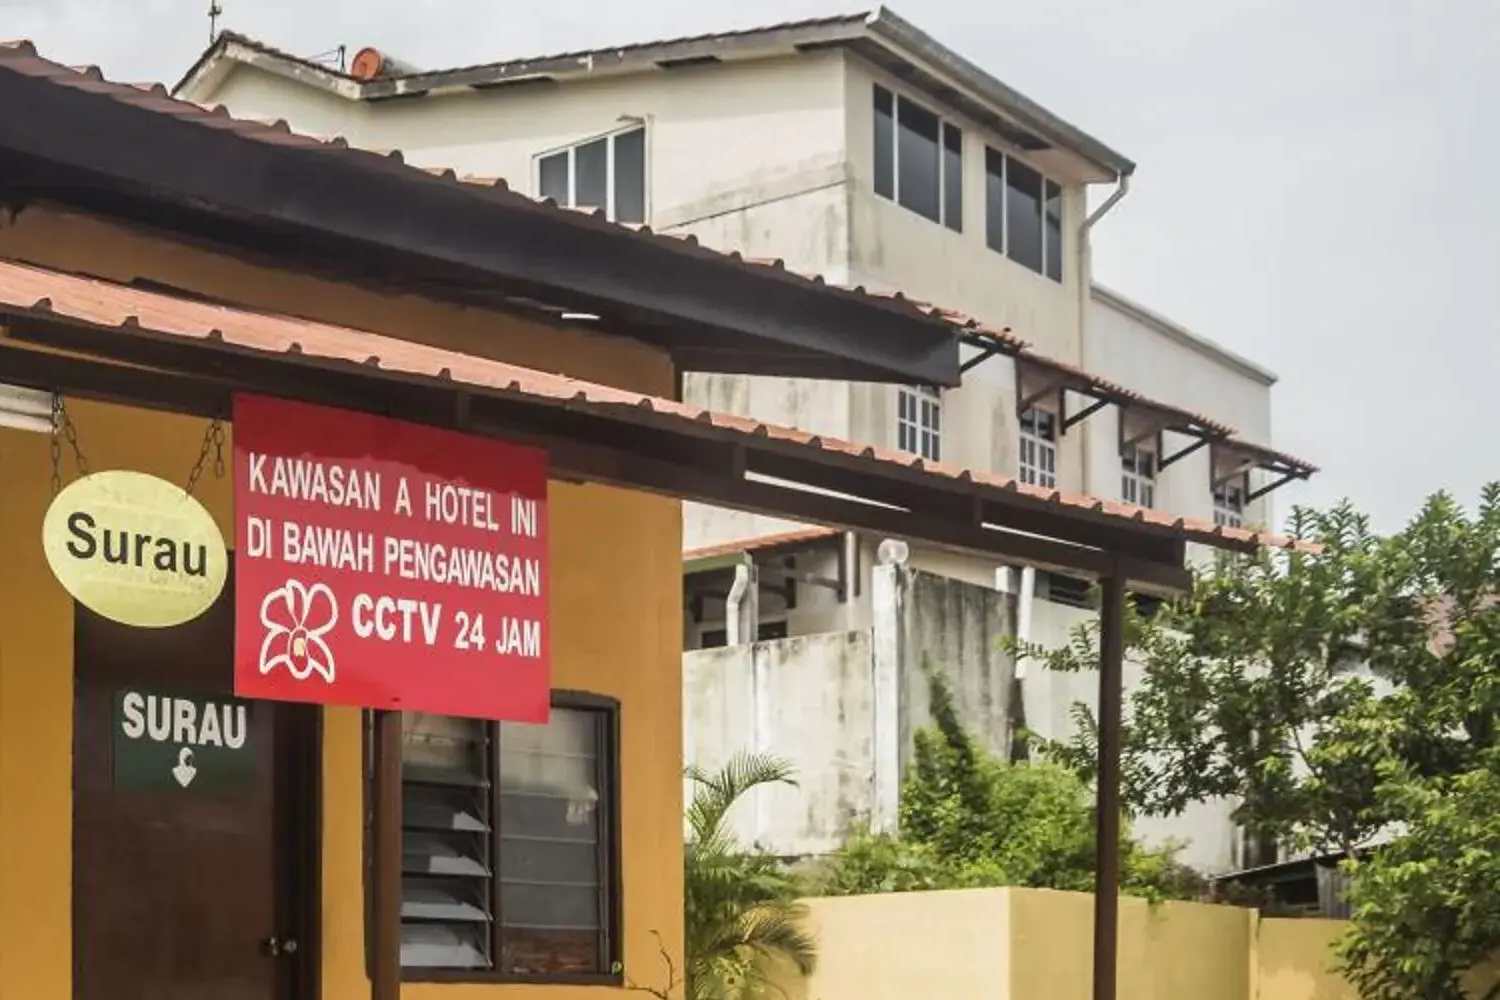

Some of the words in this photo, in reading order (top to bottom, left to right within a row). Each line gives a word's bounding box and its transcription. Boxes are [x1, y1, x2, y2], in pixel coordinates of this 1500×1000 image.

[249, 452, 380, 511] KAWASAN
[395, 477, 412, 517] A
[425, 482, 499, 531] HOTEL
[511, 497, 537, 537] INI
[66, 511, 207, 577] Surau
[247, 516, 272, 559] DI
[283, 521, 374, 573] BAWAH
[384, 536, 540, 597] PENGAWASAN
[352, 593, 442, 645] CCTV
[454, 610, 486, 651] 24
[495, 617, 541, 657] JAM
[121, 691, 247, 749] SURAU
